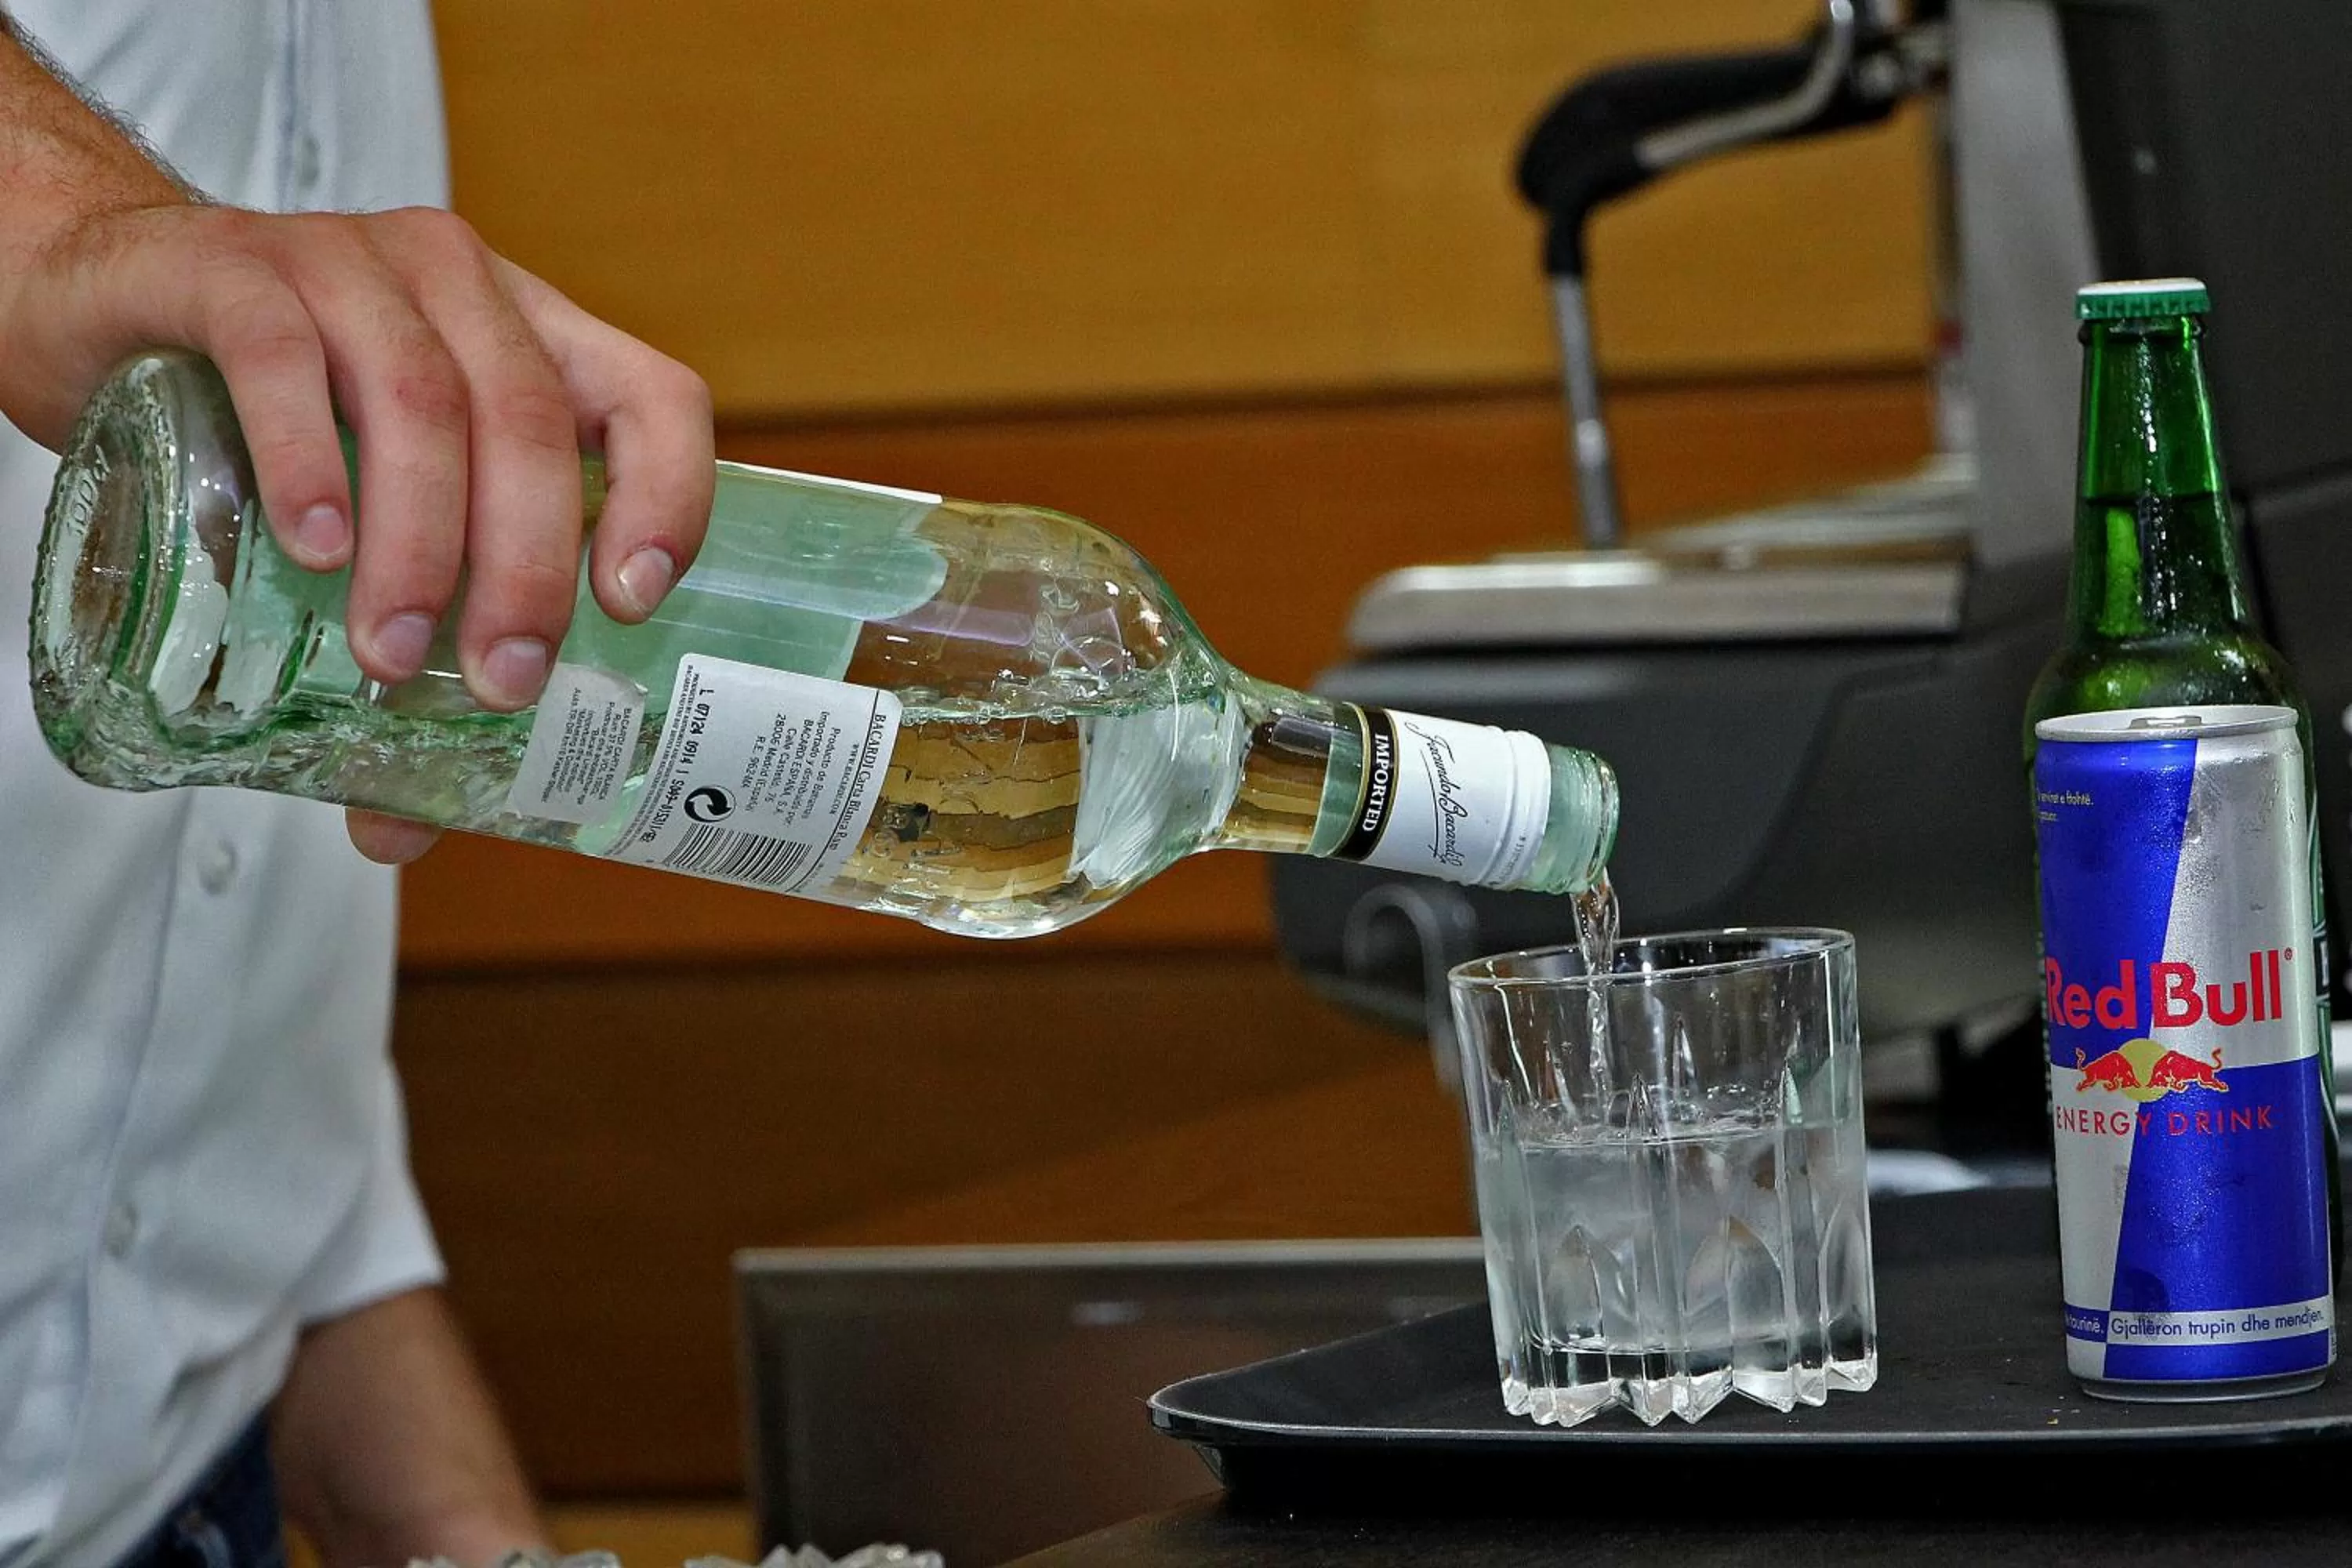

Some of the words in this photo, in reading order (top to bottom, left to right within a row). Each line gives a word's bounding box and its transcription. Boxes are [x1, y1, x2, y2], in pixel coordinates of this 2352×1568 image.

[699, 687, 713, 698] L
[688, 702, 710, 735] 07124
[794, 719, 813, 760] BACARDI
[820, 726, 840, 769] Producto
[862, 713, 886, 769] BACARDI
[816, 770, 826, 781] de
[852, 770, 872, 798] Carta
[1361, 733, 1389, 832] IMPORTED
[839, 799, 861, 830] Blanca
[2044, 955, 2138, 1030] Red
[2150, 949, 2282, 1029] Bull
[2056, 1105, 2153, 1138] ENERGY
[2168, 1104, 2273, 1136] DRINK
[2111, 1316, 2183, 1340] Gjallëron
[2188, 1318, 2235, 1339] trupin
[2241, 1313, 2270, 1333] dhe
